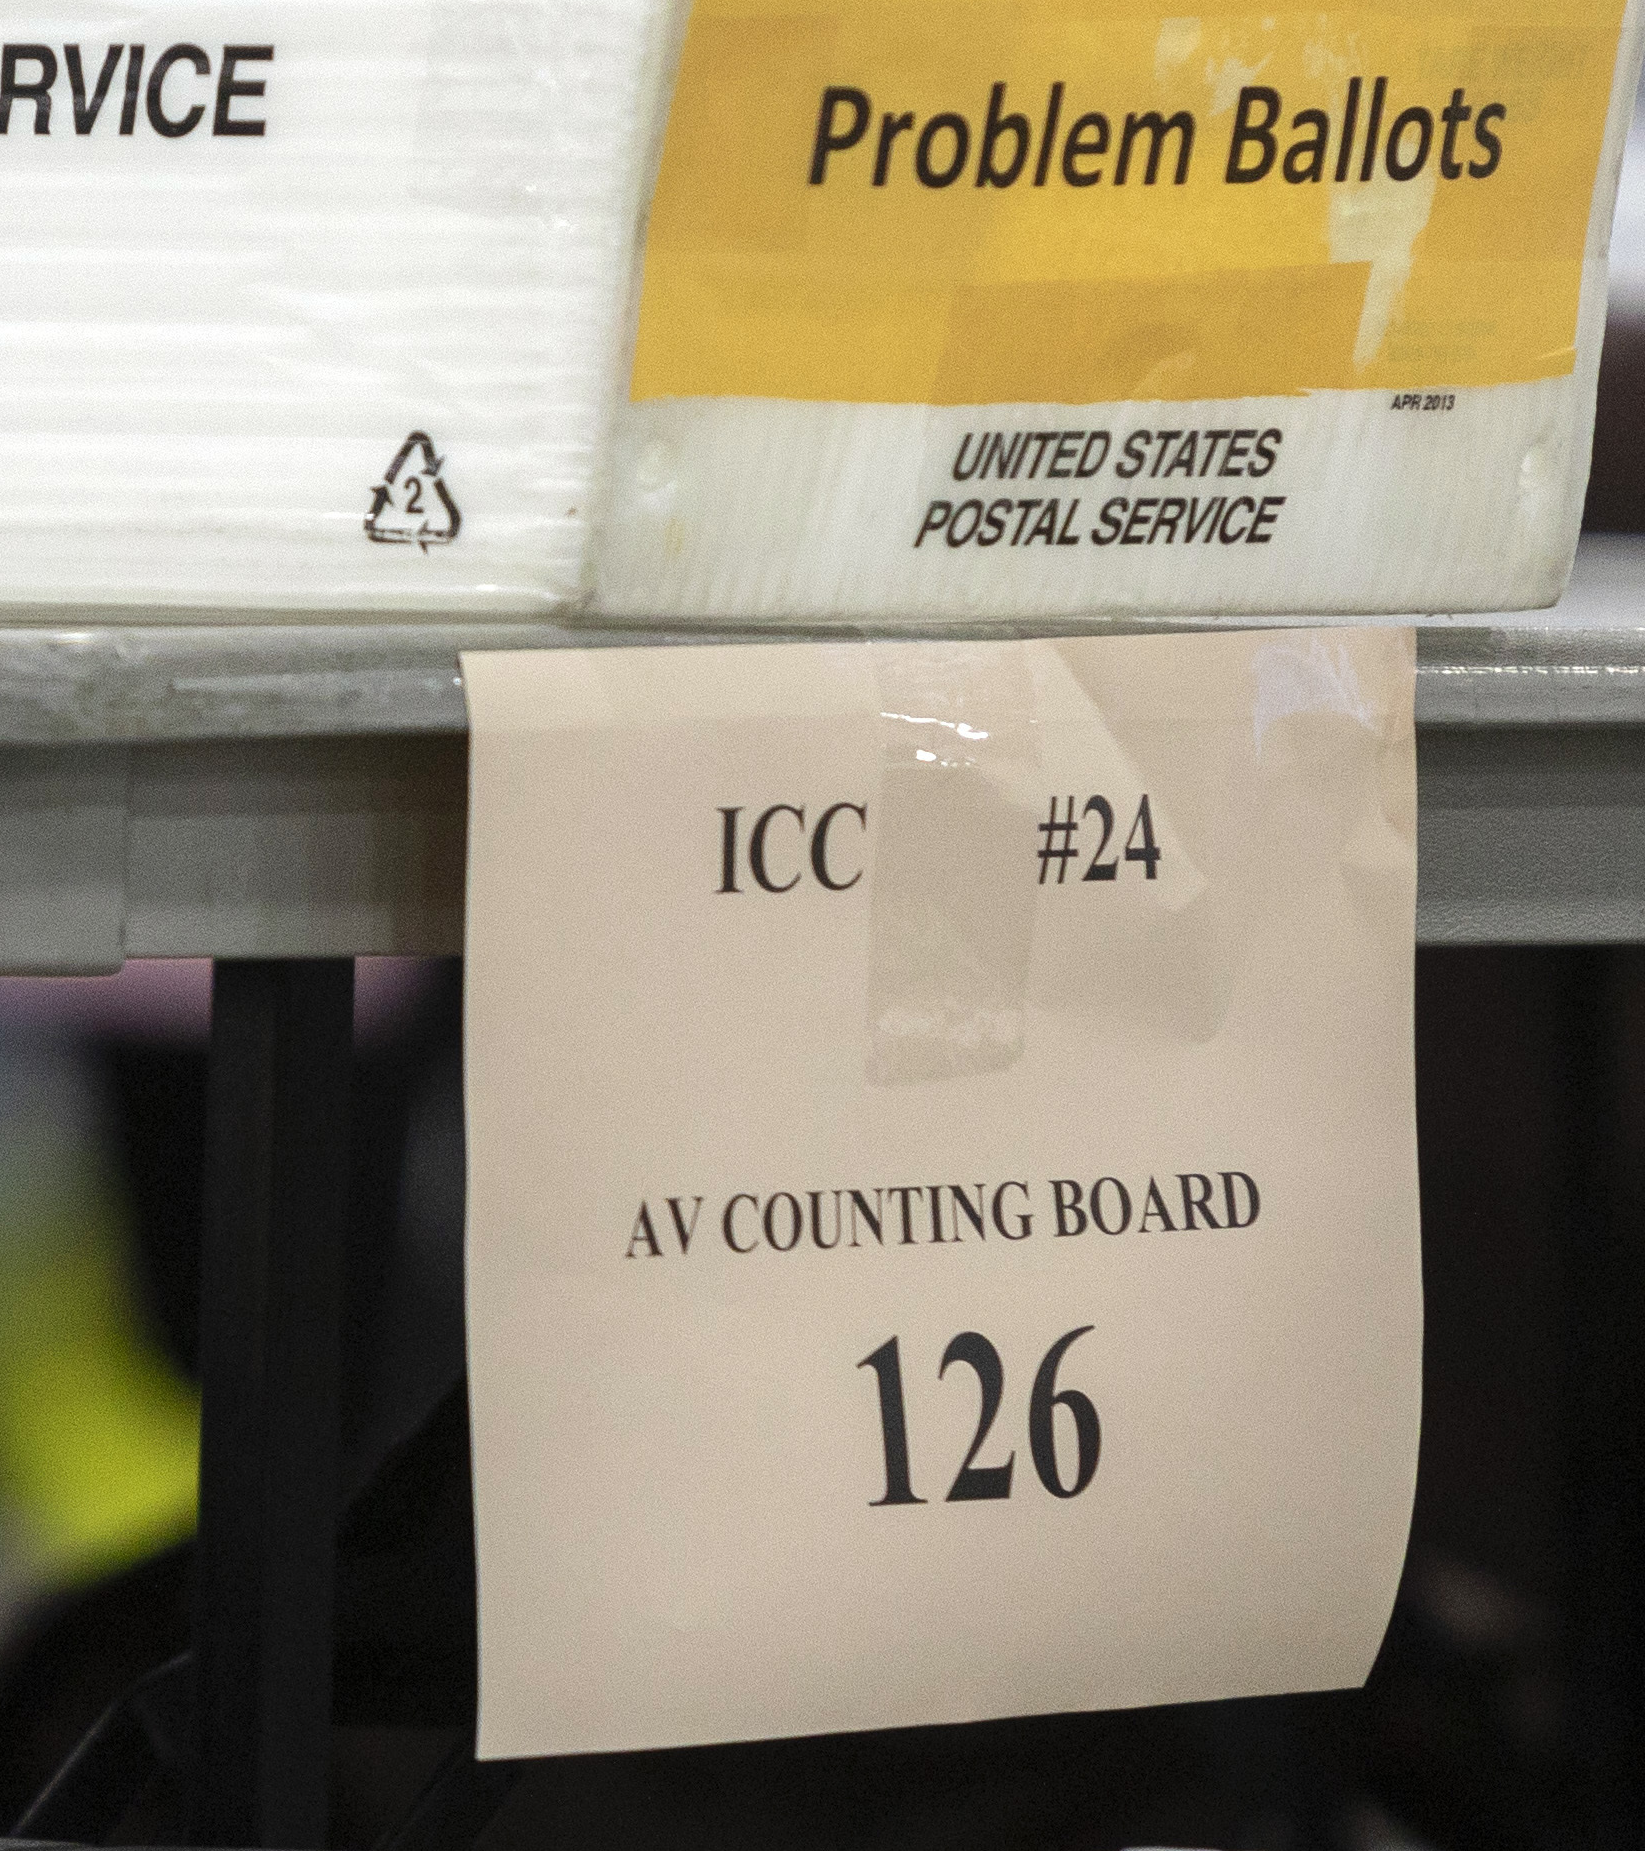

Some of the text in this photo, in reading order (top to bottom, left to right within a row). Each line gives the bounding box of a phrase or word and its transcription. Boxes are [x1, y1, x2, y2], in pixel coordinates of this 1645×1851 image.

[808, 76, 1506, 189] Problem Ballots
[1391, 393, 1457, 411] APR 2013
[952, 429, 1282, 480] UNITED STATES
[404, 476, 425, 514] 2
[915, 496, 1285, 548] POSTAL SERVICE
[719, 795, 1160, 893] ICC #24
[625, 1172, 1260, 1259] AV COUNTING BOARD
[858, 1326, 1101, 1506] 126
